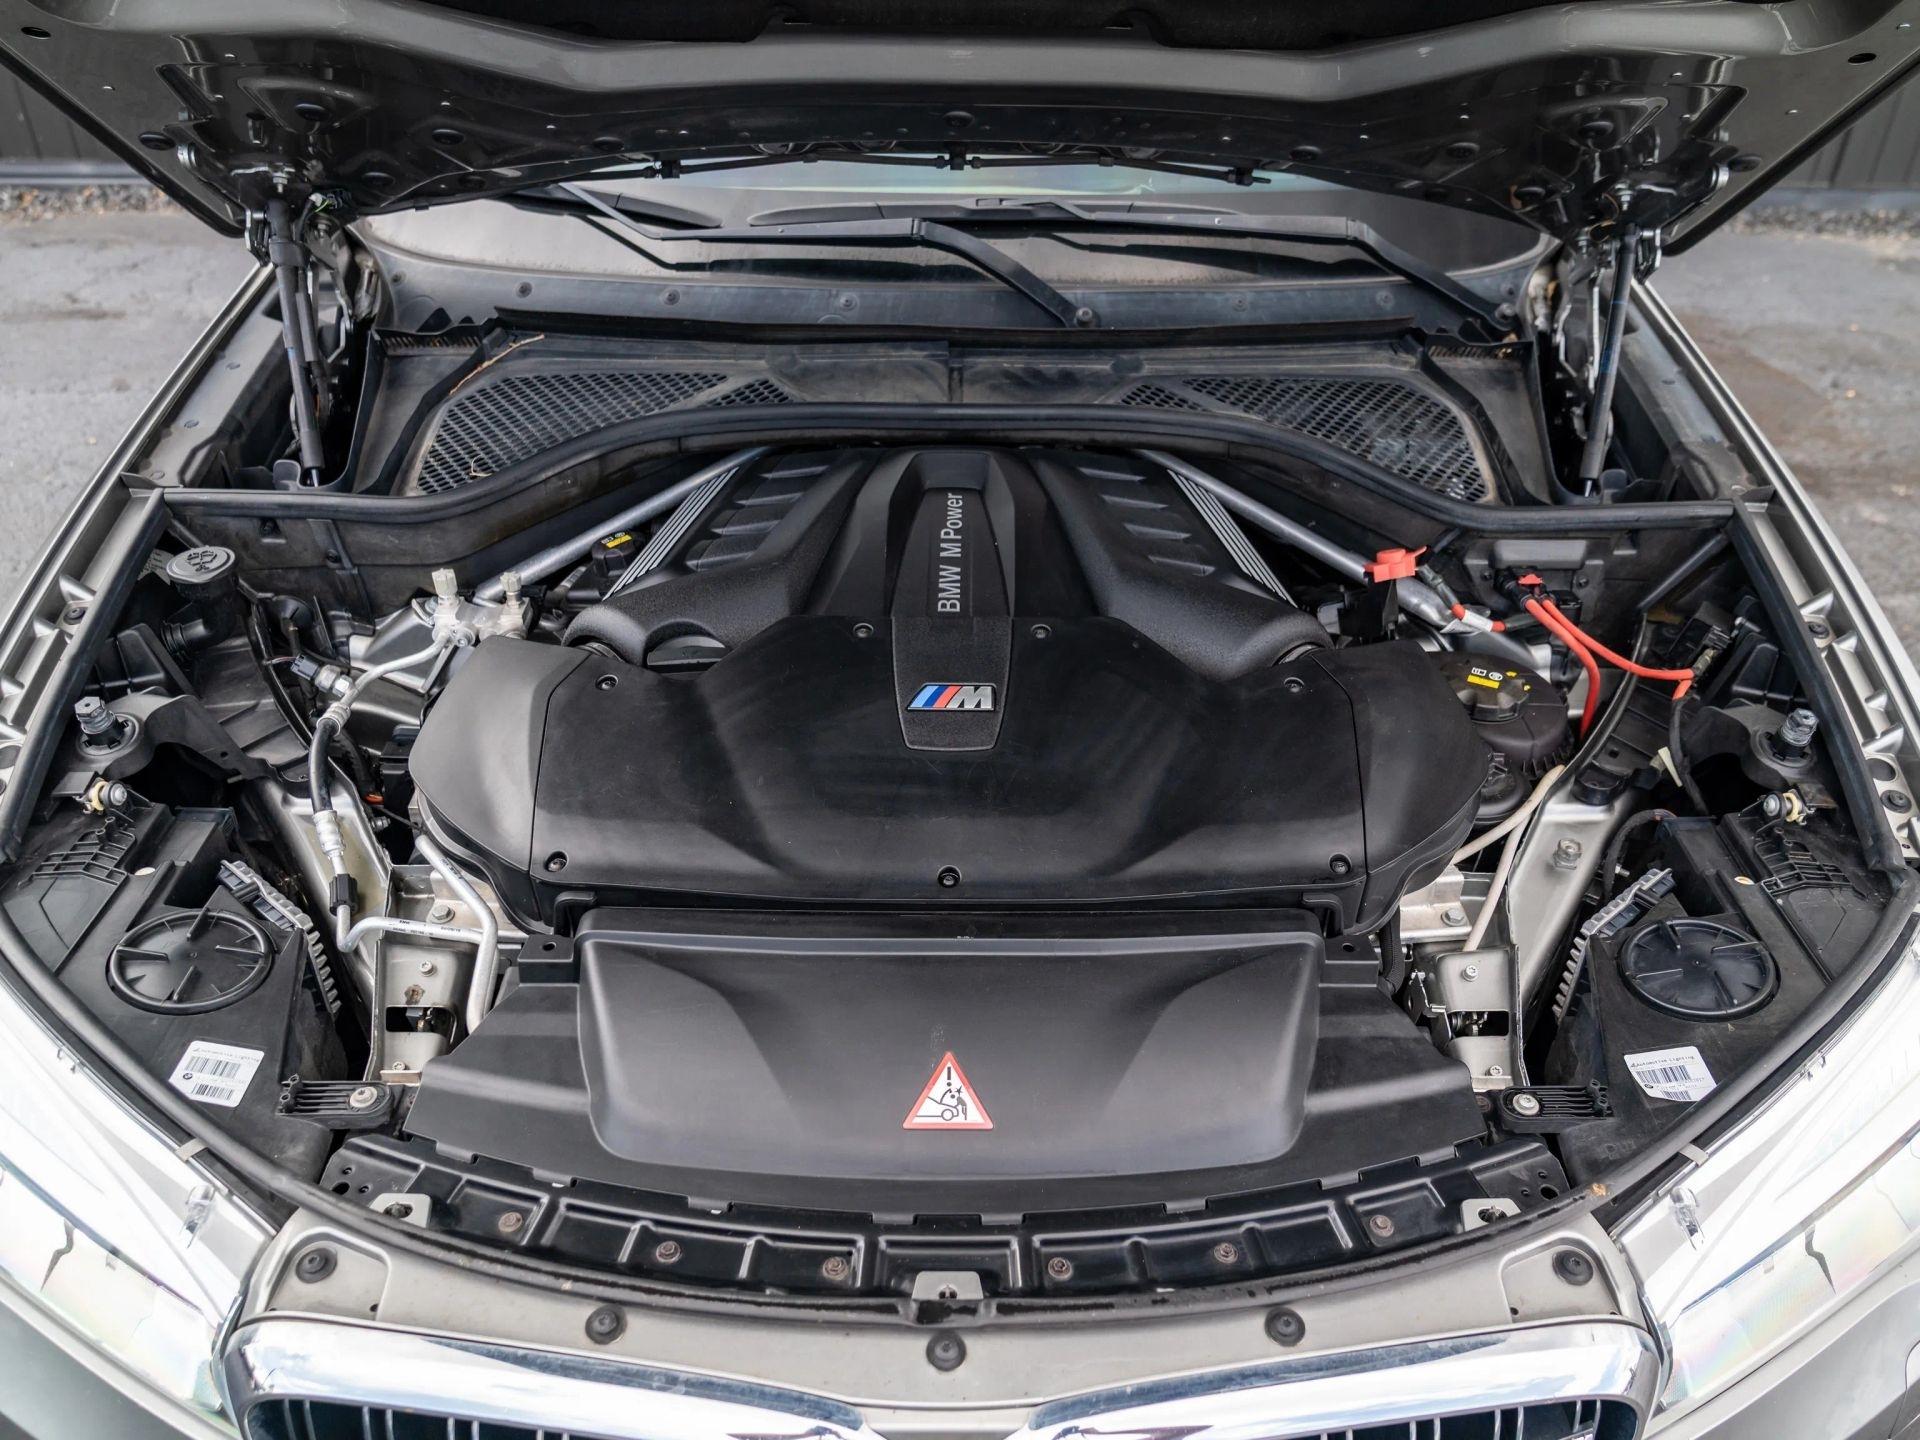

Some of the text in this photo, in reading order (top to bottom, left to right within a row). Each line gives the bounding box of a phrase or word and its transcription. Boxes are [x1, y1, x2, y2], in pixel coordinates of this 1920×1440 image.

[938, 492, 963, 613] BMW M Power
